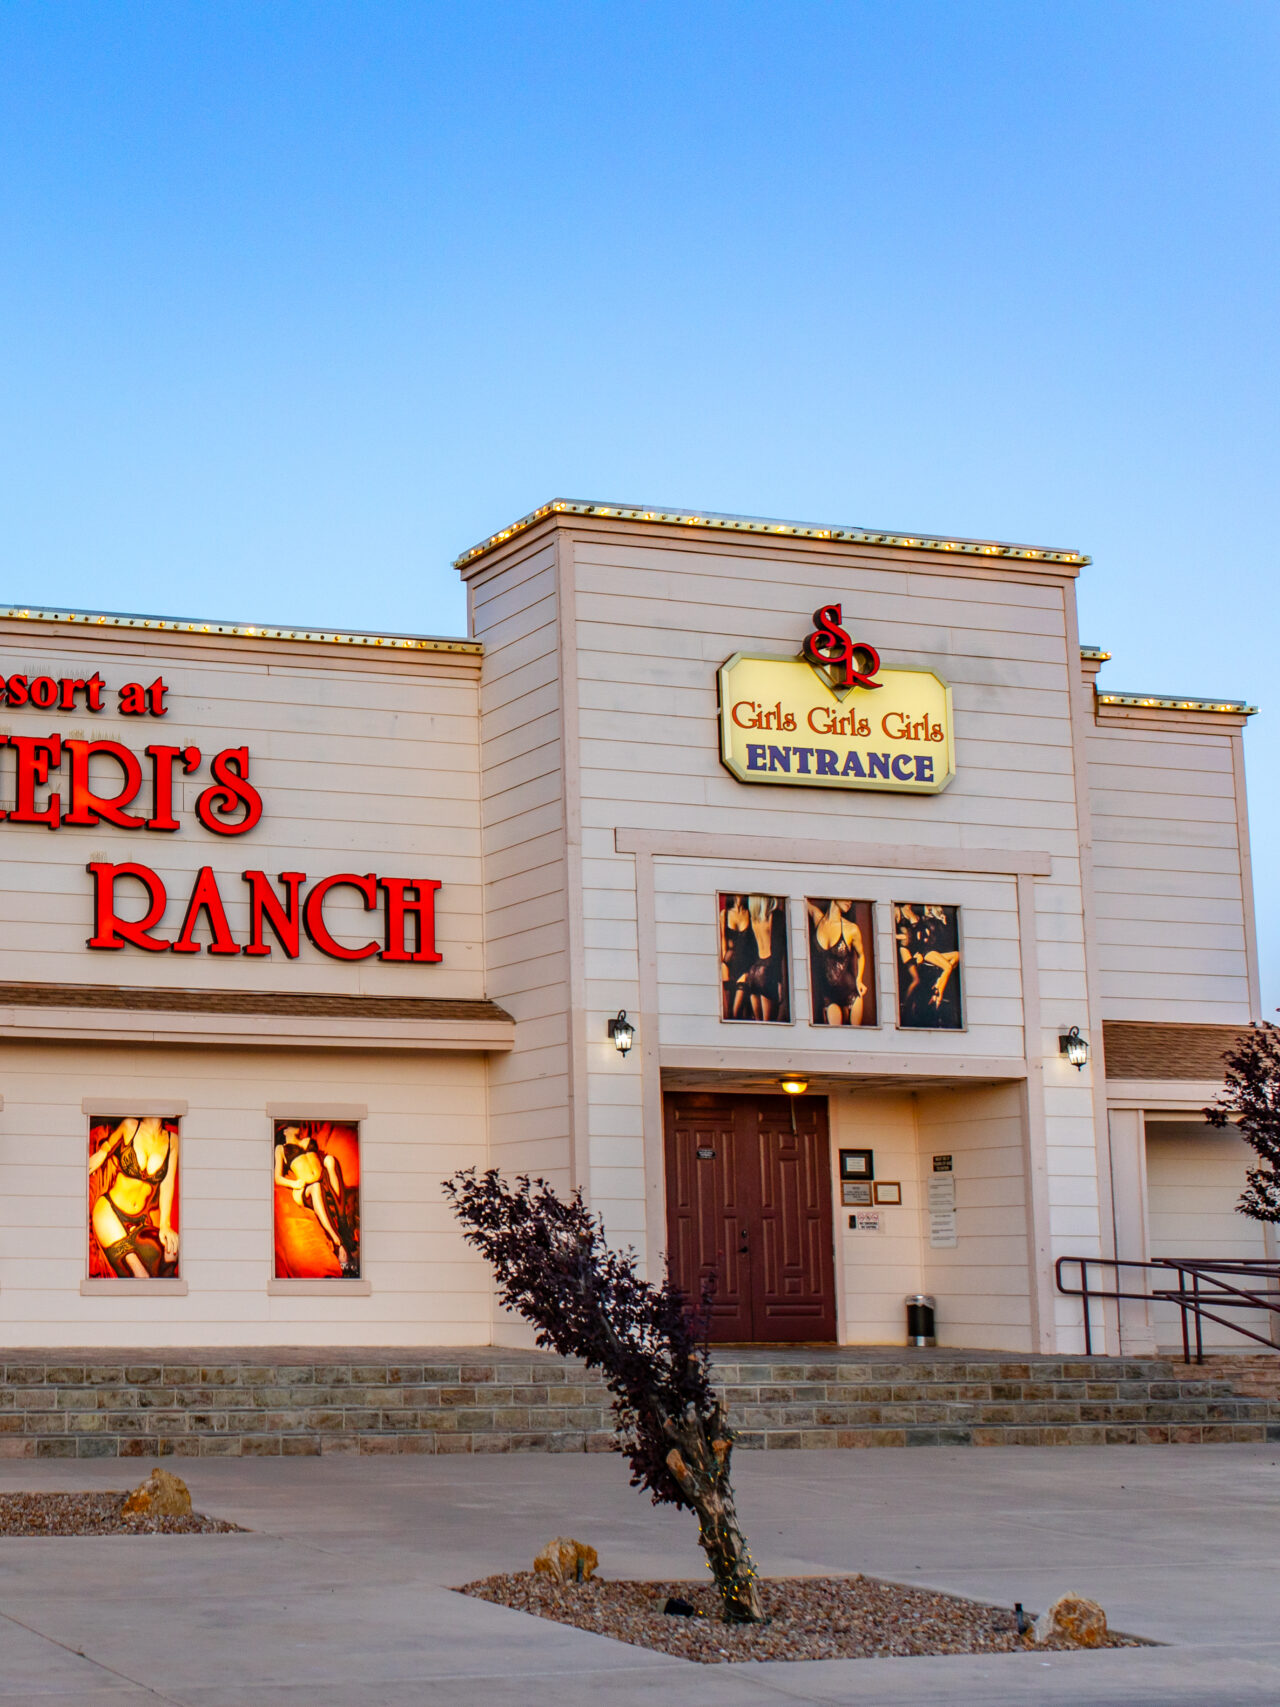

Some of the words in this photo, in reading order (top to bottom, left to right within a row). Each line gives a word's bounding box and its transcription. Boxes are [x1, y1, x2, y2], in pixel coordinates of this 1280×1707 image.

[118, 676, 170, 717] at
[731, 701, 797, 731] Girls
[807, 706, 871, 737] Girls
[881, 712, 944, 742] Girls
[746, 743, 934, 782] ENTRANCE
[86, 861, 443, 963] RANCH
